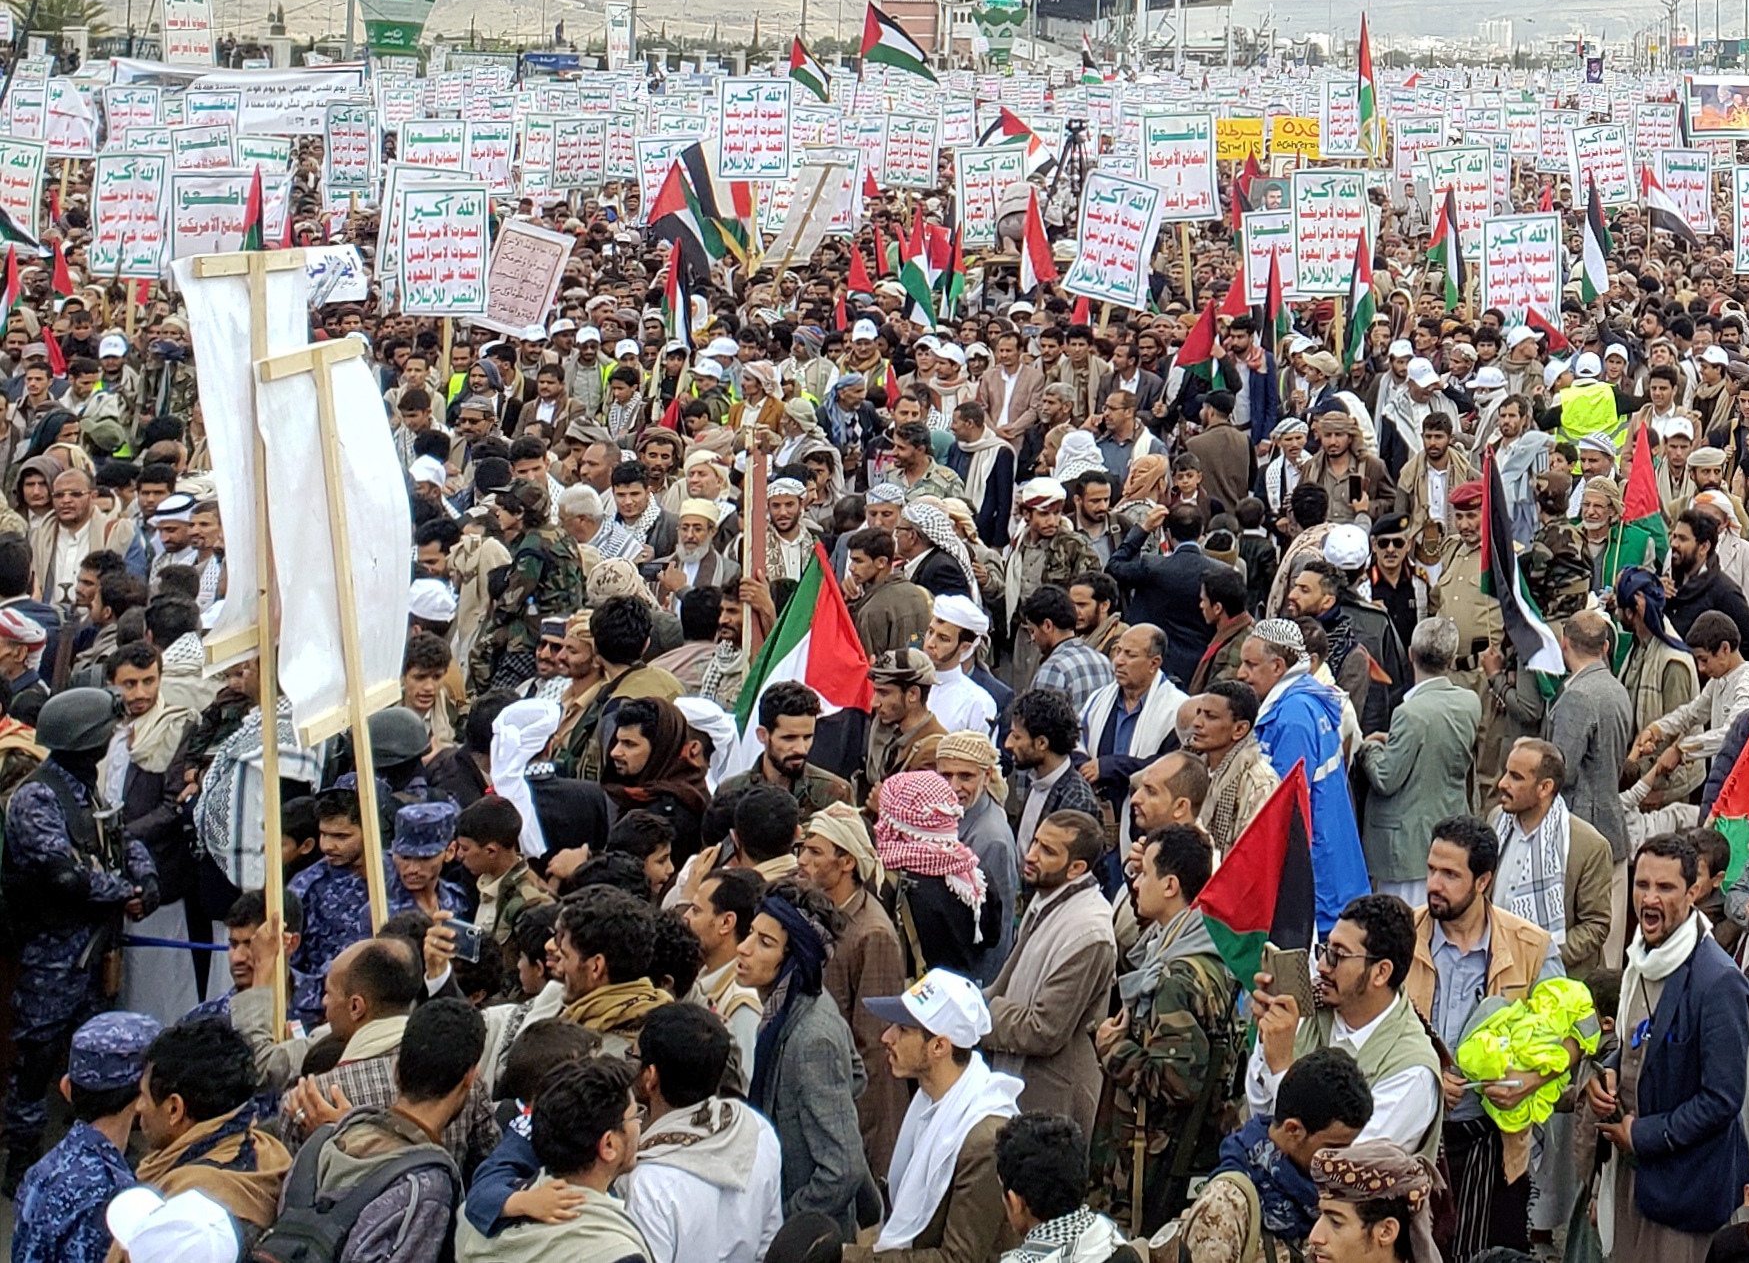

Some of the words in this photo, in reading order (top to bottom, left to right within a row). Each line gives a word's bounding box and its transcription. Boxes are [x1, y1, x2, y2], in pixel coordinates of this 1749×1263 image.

[726, 84, 763, 104] أكبر
[765, 87, 786, 101] الله
[761, 109, 786, 120] الموت
[760, 125, 785, 137] الموت
[724, 142, 751, 153] اليهود
[751, 142, 762, 154] على
[766, 141, 785, 151] اللعنة
[723, 157, 755, 174] للإسلام
[757, 158, 785, 174] النصر
[1149, 148, 1180, 169] الأمريكية
[1182, 150, 1207, 168] البضائع
[102, 158, 138, 187] أكبر
[140, 163, 159, 181] الله
[1300, 177, 1336, 206] أكبر
[1339, 180, 1363, 197] الله
[409, 193, 454, 224] أكبر
[457, 197, 481, 216] الله
[1337, 206, 1365, 221] الموت
[408, 222, 448, 241] لأمريكا
[451, 225, 481, 240] الموت
[1489, 222, 1527, 251] أكبر
[1529, 224, 1554, 242] الله
[407, 246, 448, 263] لإسرائيل
[451, 246, 482, 262] الموت
[407, 267, 436, 284] اليهود
[440, 267, 454, 283] على
[459, 266, 480, 279] اللعنة
[1302, 266, 1333, 284] للإسلام
[408, 285, 445, 310] للإسلام
[448, 285, 481, 307] النصر
